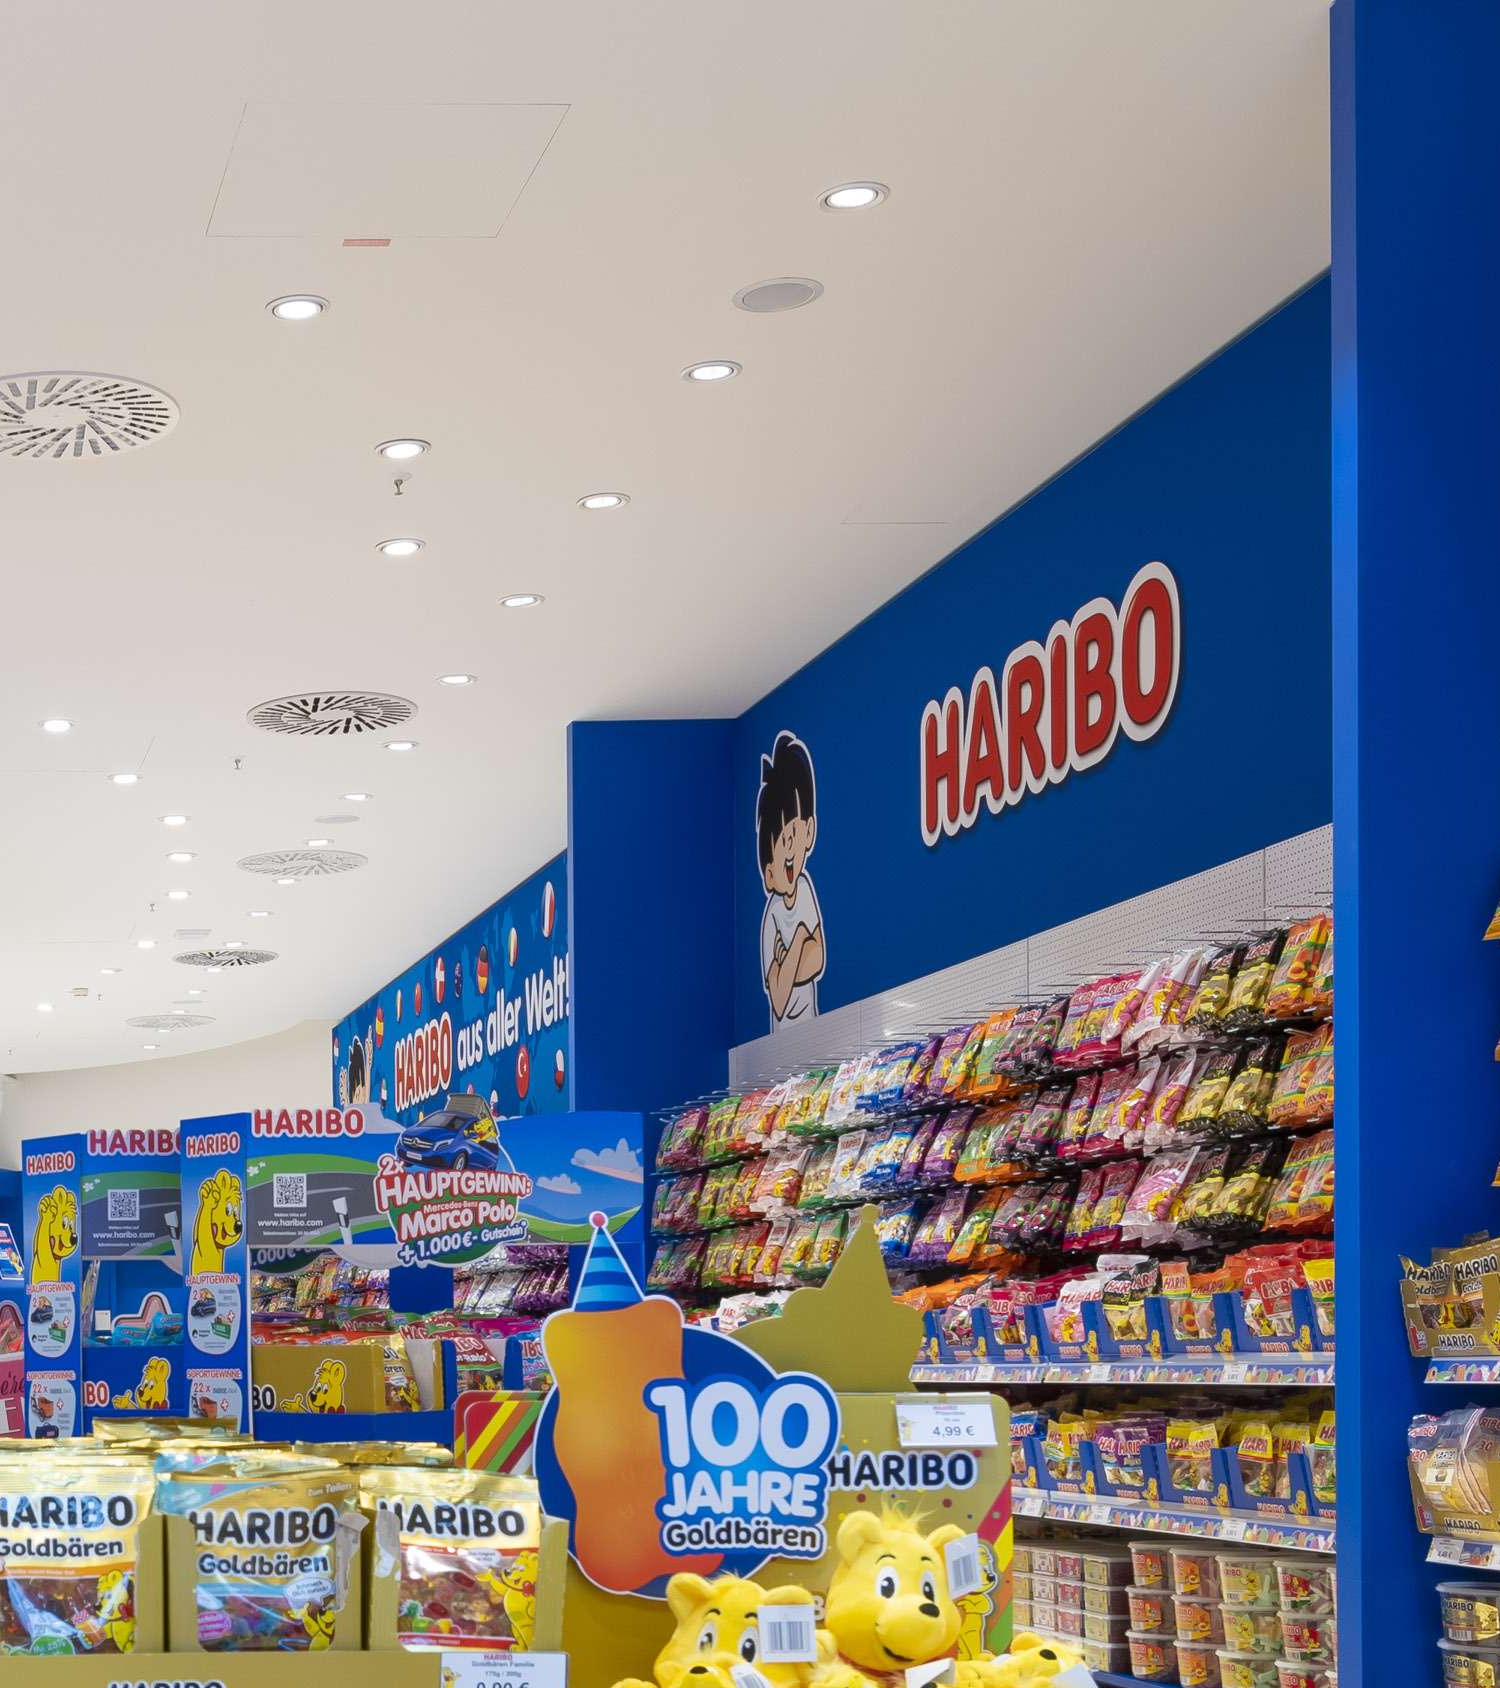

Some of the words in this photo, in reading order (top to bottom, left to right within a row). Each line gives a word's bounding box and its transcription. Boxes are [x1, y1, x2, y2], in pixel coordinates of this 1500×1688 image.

[925, 578, 1172, 834] HARIBO
[395, 1018, 450, 1110] HARIBO
[457, 1020, 483, 1071] aus
[487, 989, 521, 1056] aller
[525, 952, 569, 1035] Welt!
[254, 1110, 364, 1135] HARIBO
[187, 1134, 238, 1156] HARIBO
[27, 1153, 75, 1174] HARIBO
[380, 1172, 531, 1210] HAUPTGEWINN:
[258, 1218, 323, 1227] www.haribo.com
[401, 1210, 473, 1240] Marco
[478, 1200, 515, 1224] Polo
[93, 1231, 155, 1240] www.haribo.com
[650, 1381, 830, 1467] 100
[933, 1426, 961, 1437] 4,99
[966, 1425, 976, 1436] €
[828, 1454, 974, 1487] HARIBO
[663, 1470, 820, 1518] JAHRE
[190, 1506, 335, 1546] HARIBO
[666, 1520, 816, 1548] Goldbären
[199, 1554, 328, 1577] Goldbären
